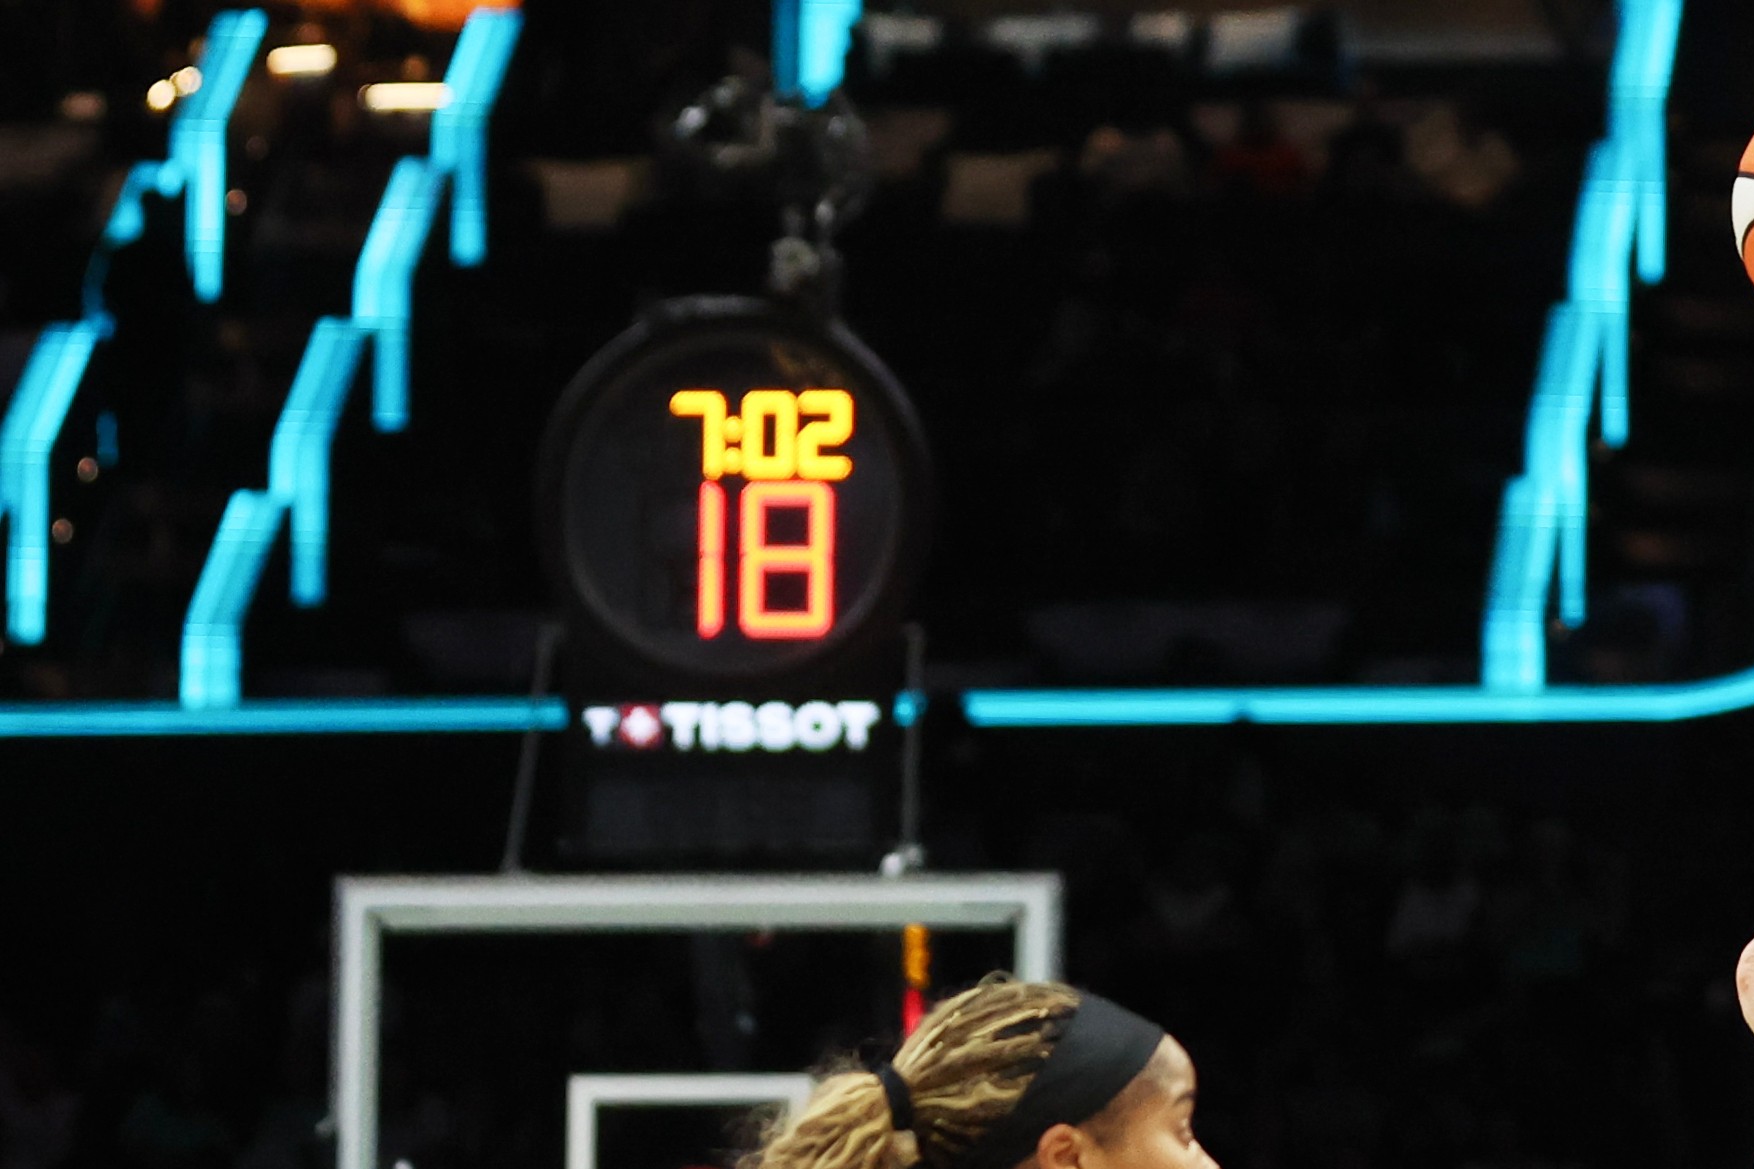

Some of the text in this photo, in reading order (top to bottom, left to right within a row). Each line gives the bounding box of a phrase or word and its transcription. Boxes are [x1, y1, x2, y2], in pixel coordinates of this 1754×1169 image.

[669, 390, 854, 481] 7:02
[696, 478, 836, 641] 18
[661, 701, 880, 752] TISSOT
